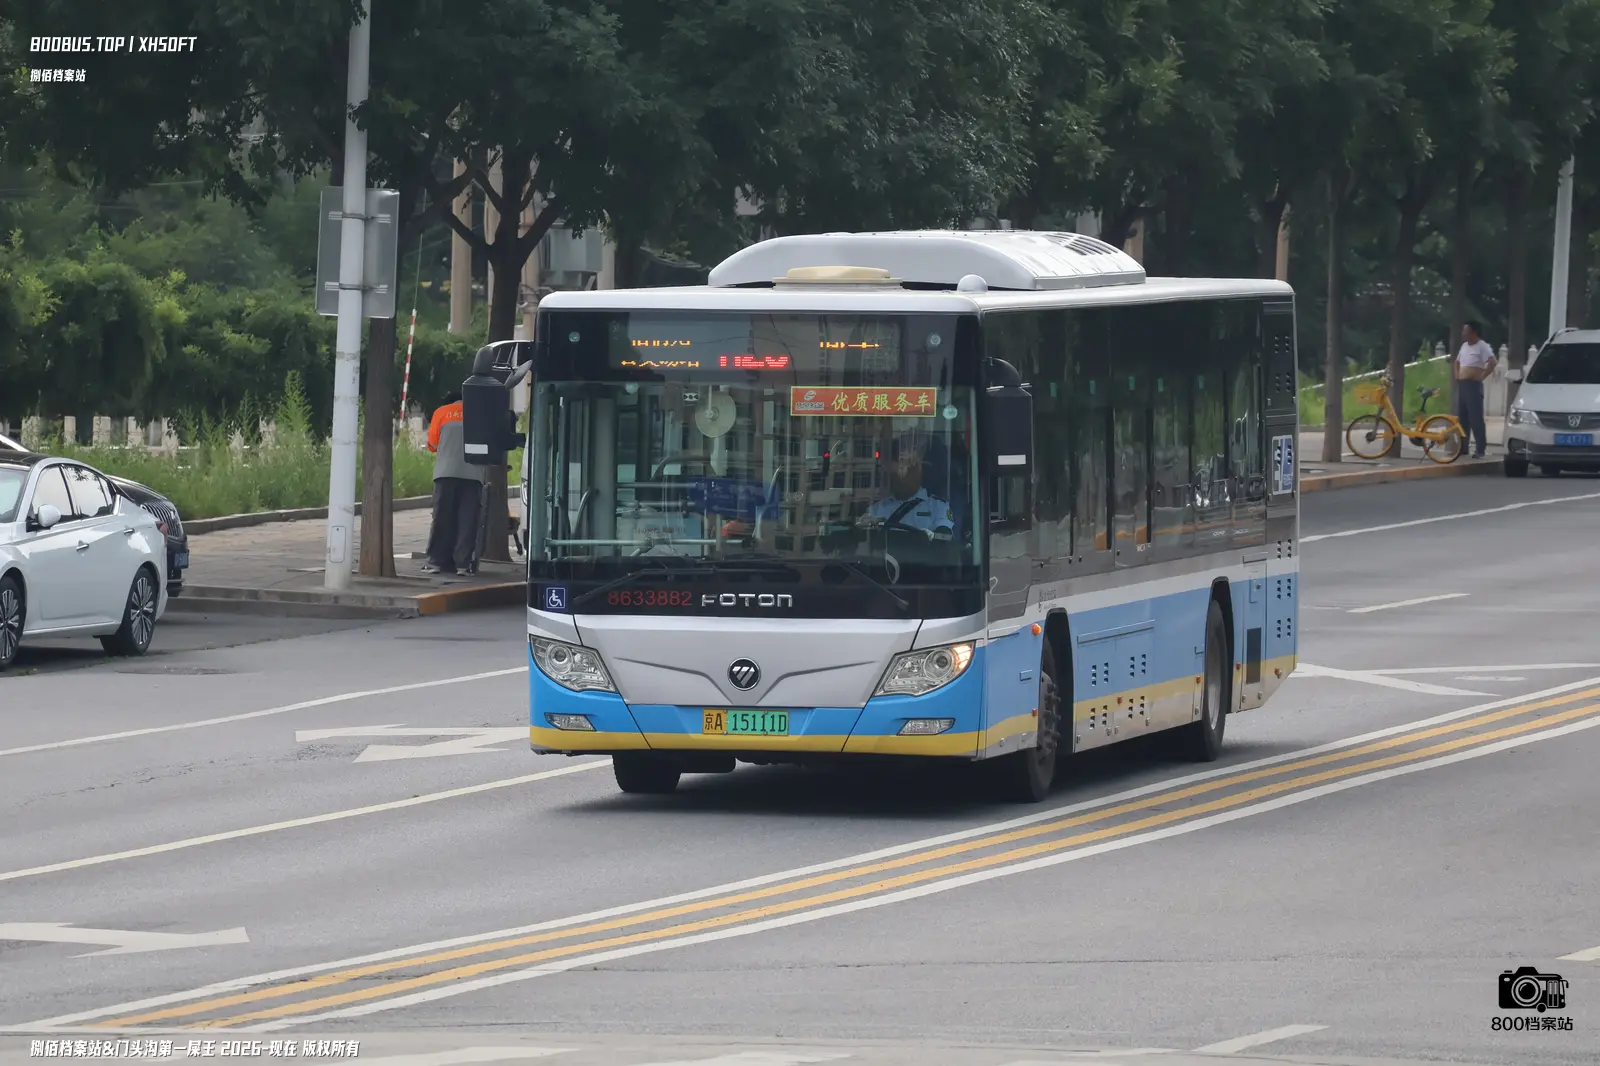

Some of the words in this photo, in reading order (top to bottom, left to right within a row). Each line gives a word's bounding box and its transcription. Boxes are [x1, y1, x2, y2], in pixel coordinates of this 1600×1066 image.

[831, 392, 932, 413] 优质服务车
[608, 590, 693, 607] 8633882
[701, 593, 793, 608] FOTON
